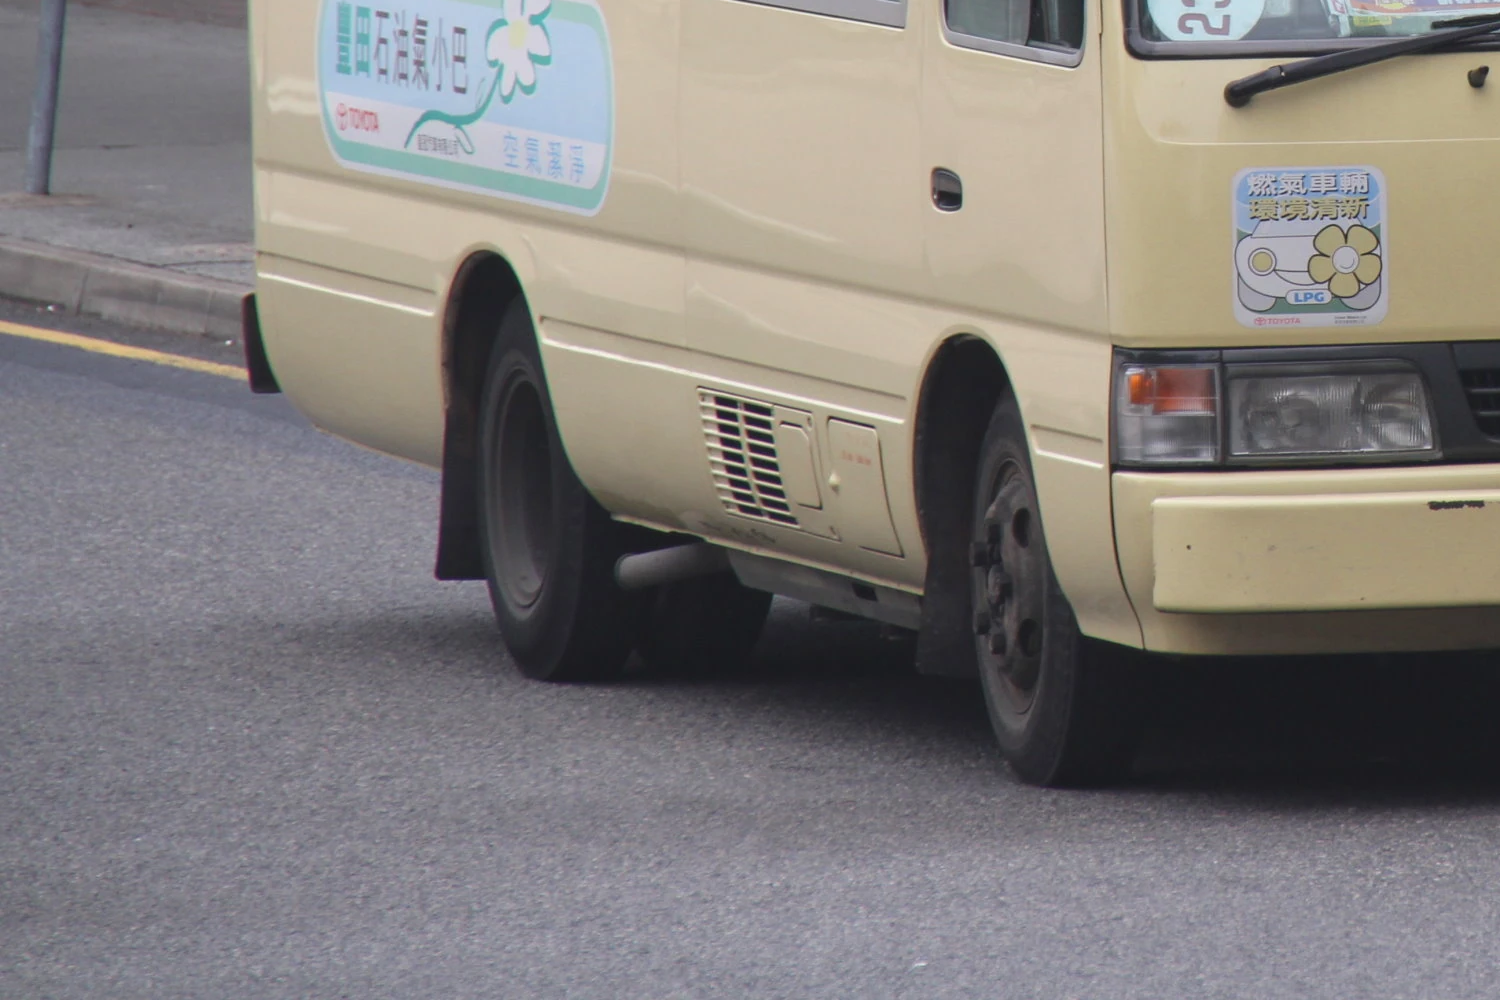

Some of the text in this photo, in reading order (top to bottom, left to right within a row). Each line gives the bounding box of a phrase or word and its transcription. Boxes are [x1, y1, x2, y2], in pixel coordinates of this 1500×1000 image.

[1247, 172, 1370, 197] 燃氣車輛
[1249, 197, 1370, 221] 環境清新
[1293, 292, 1325, 303] LPG
[1266, 317, 1301, 325] TOYOTA
